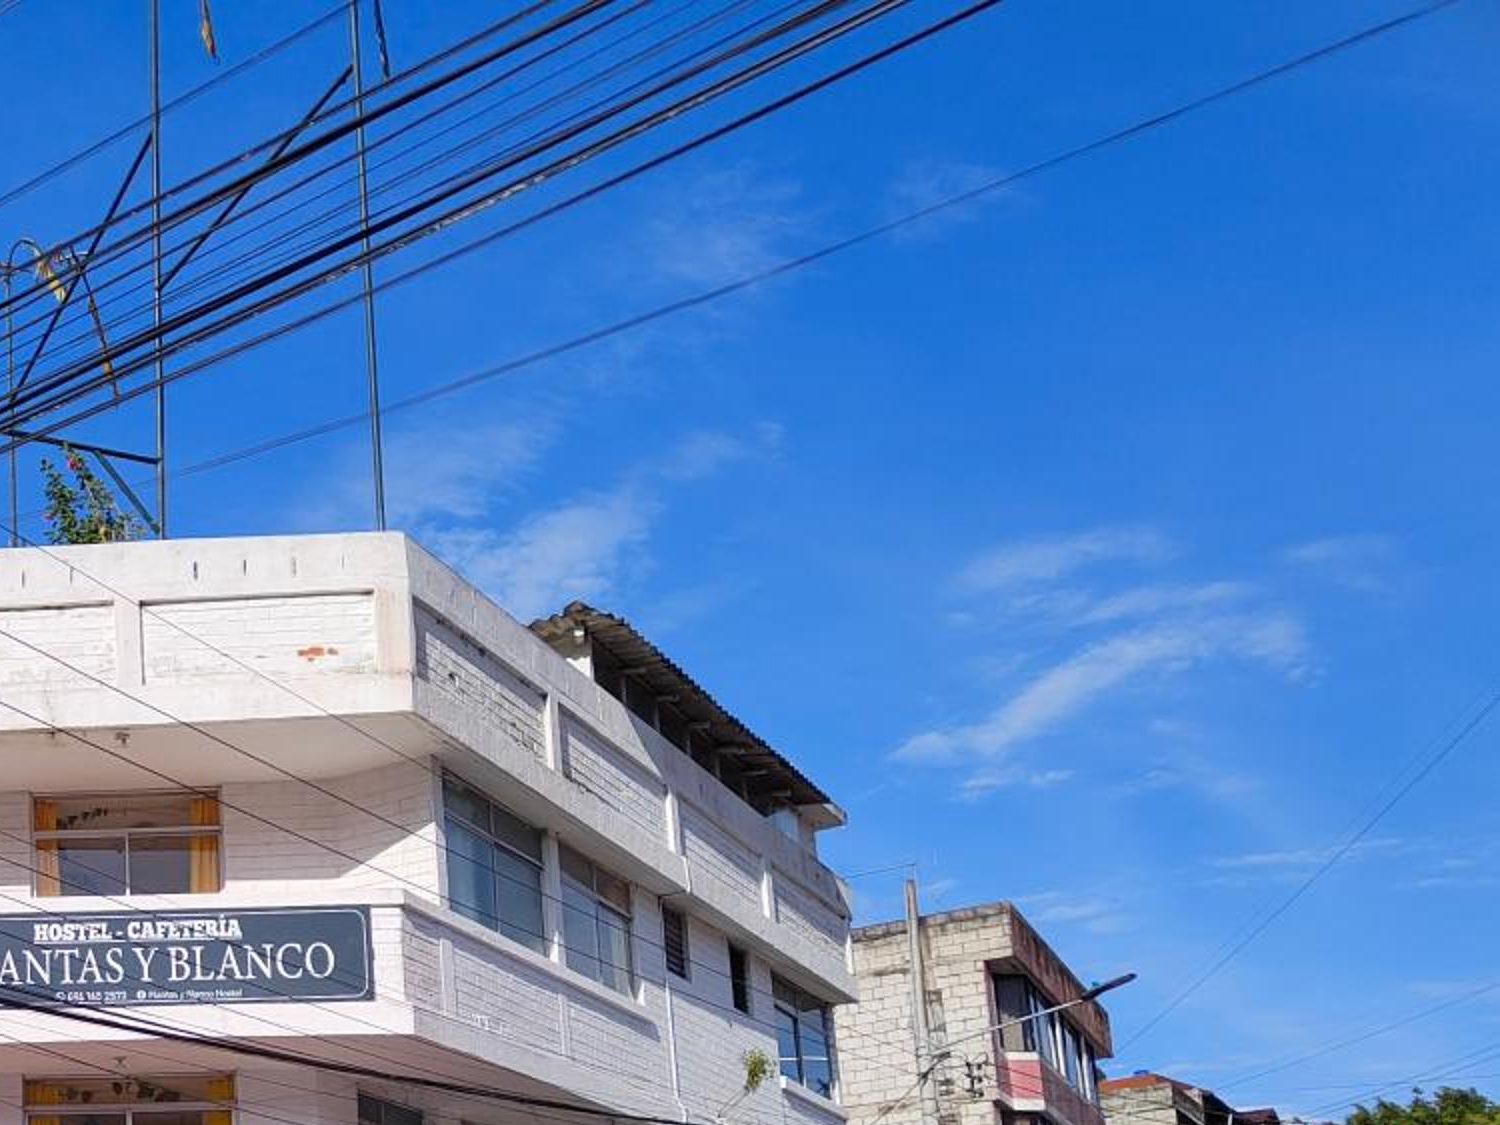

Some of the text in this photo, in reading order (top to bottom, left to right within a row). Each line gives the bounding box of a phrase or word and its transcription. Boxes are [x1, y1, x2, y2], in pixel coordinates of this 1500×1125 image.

[34, 922, 113, 942] HOSTEL
[127, 914, 243, 940] CAFETERÍA
[132, 946, 159, 982] Y
[168, 941, 335, 982] BLANCO
